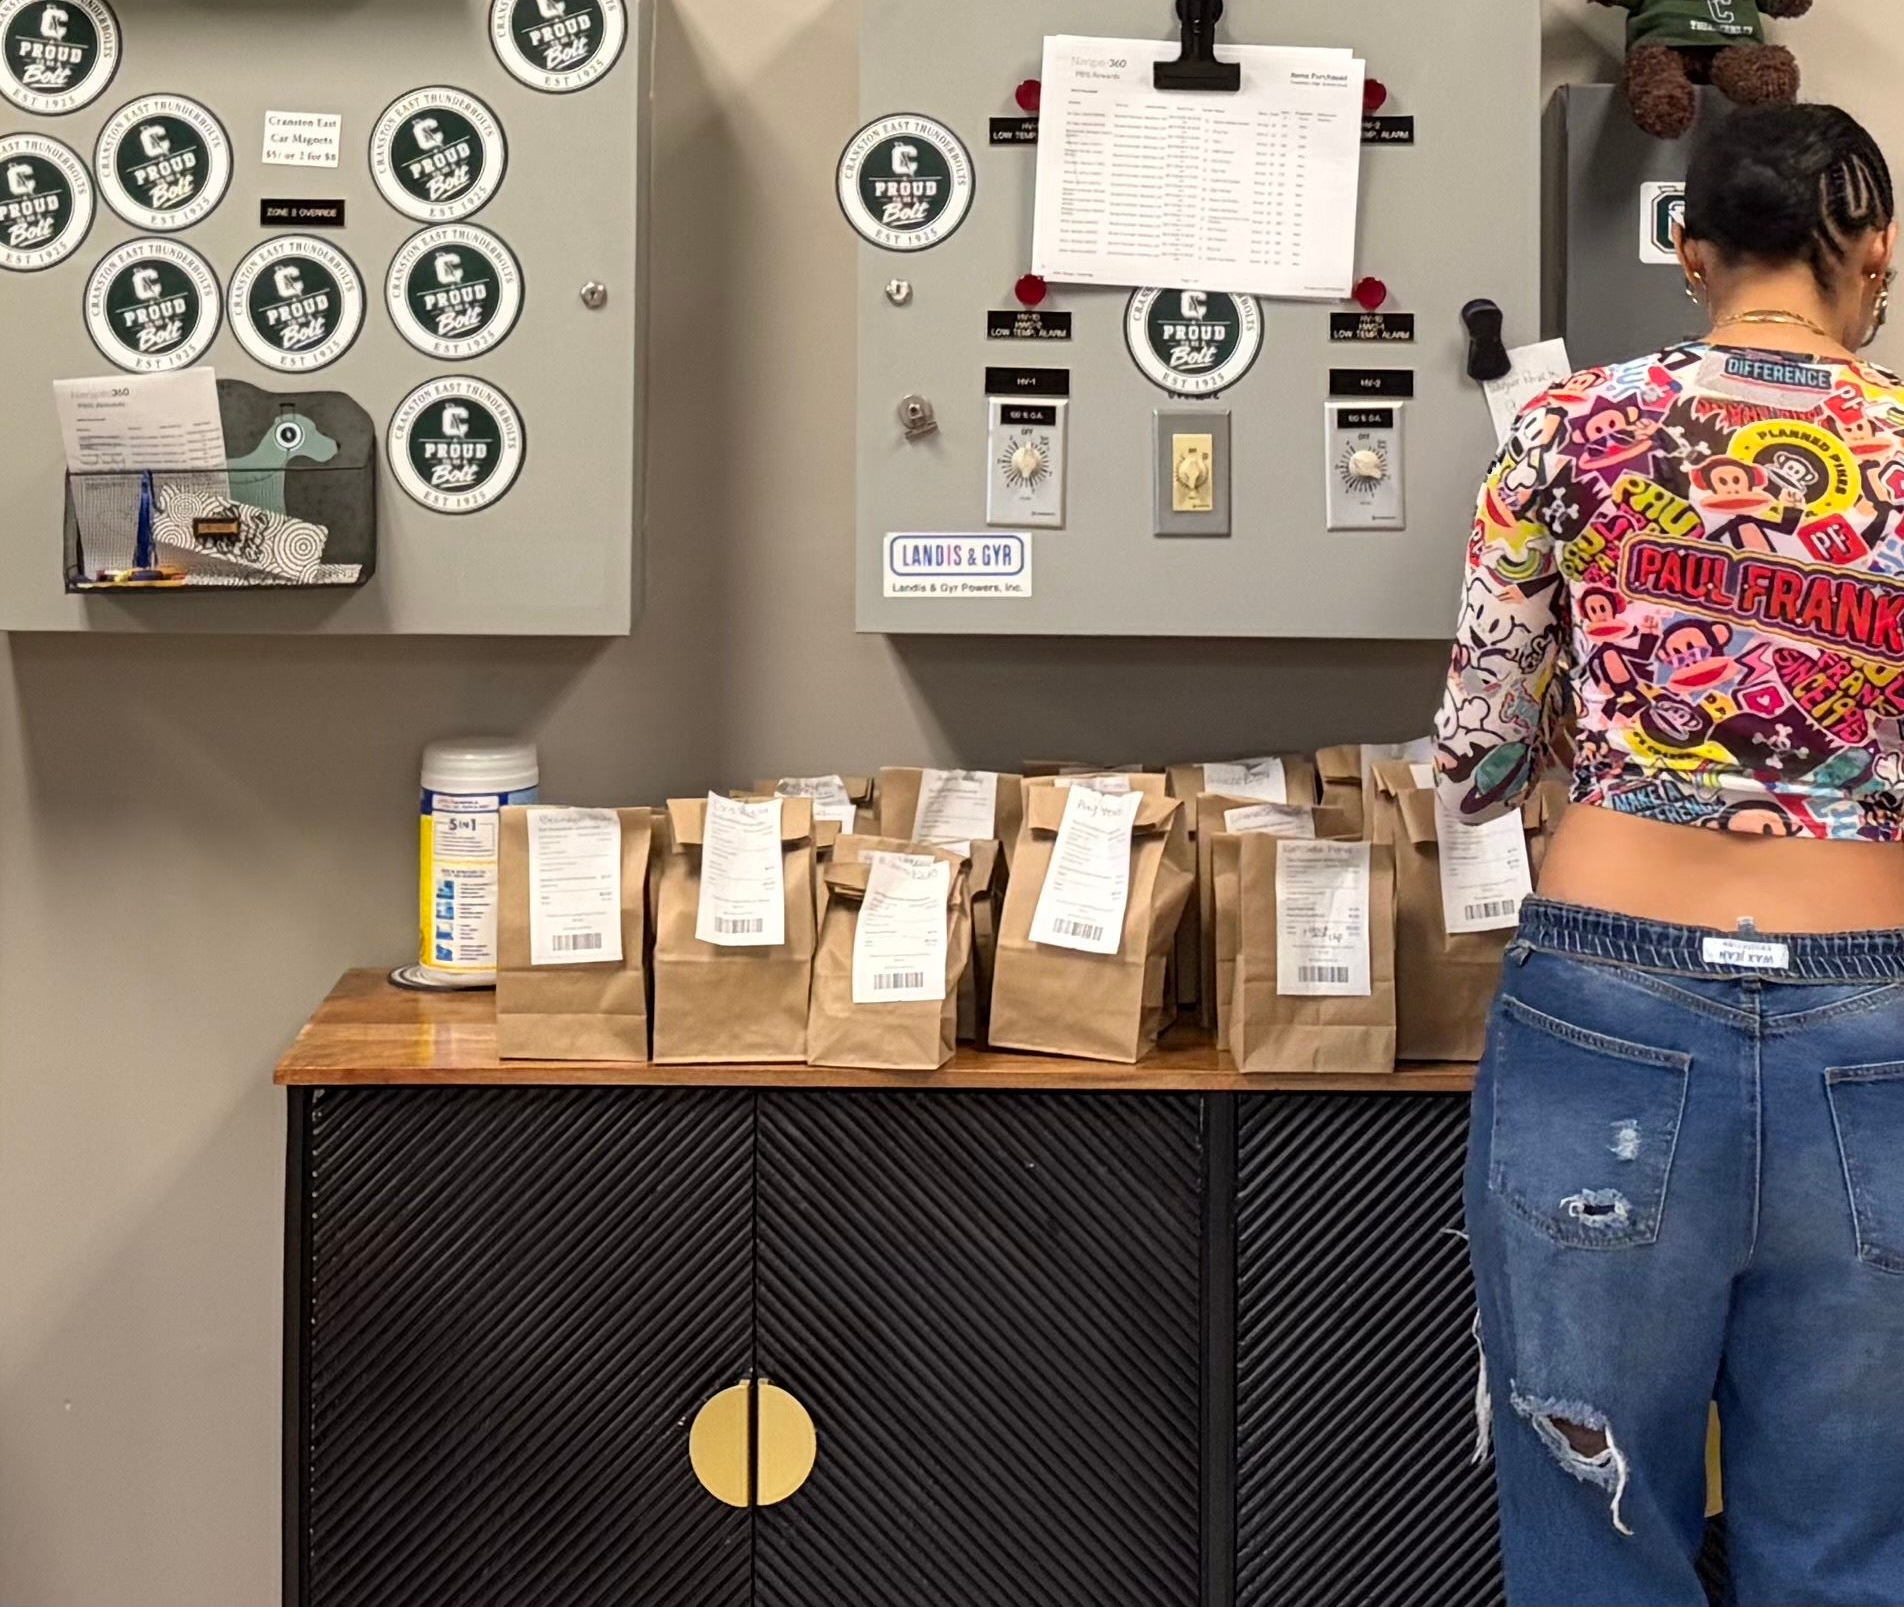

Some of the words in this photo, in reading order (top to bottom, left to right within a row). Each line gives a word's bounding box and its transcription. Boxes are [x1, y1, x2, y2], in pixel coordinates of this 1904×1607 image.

[529, 14, 591, 46] PROUD
[19, 41, 83, 63] PROUD
[543, 37, 589, 69] Bolt
[22, 64, 73, 84] Bolt
[268, 115, 313, 127] Cranston
[317, 118, 337, 128] East
[882, 121, 909, 133] EAST
[271, 134, 288, 143] Car
[292, 134, 333, 146] Magnets
[134, 152, 196, 186] PROUD
[409, 142, 471, 179] PROUD
[148, 174, 195, 208] Bolt
[424, 165, 470, 201] Bolt
[875, 181, 937, 197] PROUD
[881, 201, 930, 224] Bolt
[7, 216, 54, 247] Bolt
[424, 284, 487, 310] PROUD
[123, 298, 186, 327] PROUD
[266, 294, 329, 326] PROUD
[435, 306, 482, 336] Bolt
[136, 320, 183, 351] Bolt
[279, 316, 326, 349] Bolt
[991, 328, 1010, 336] LOW
[1162, 325, 1226, 340] PROUD
[1333, 330, 1353, 338] LOW
[1169, 346, 1218, 367] Bolt
[1725, 357, 1831, 389] DIFFERENCE
[435, 383, 462, 395] EAST
[424, 443, 487, 458] PROUD
[431, 463, 480, 486] Bolt
[902, 544, 962, 567] LANDIS
[968, 547, 977, 566] &
[982, 544, 1012, 566] GYR
[1633, 544, 1735, 606] PAUL
[892, 583, 927, 593] Landis
[449, 819, 457, 831] 5
